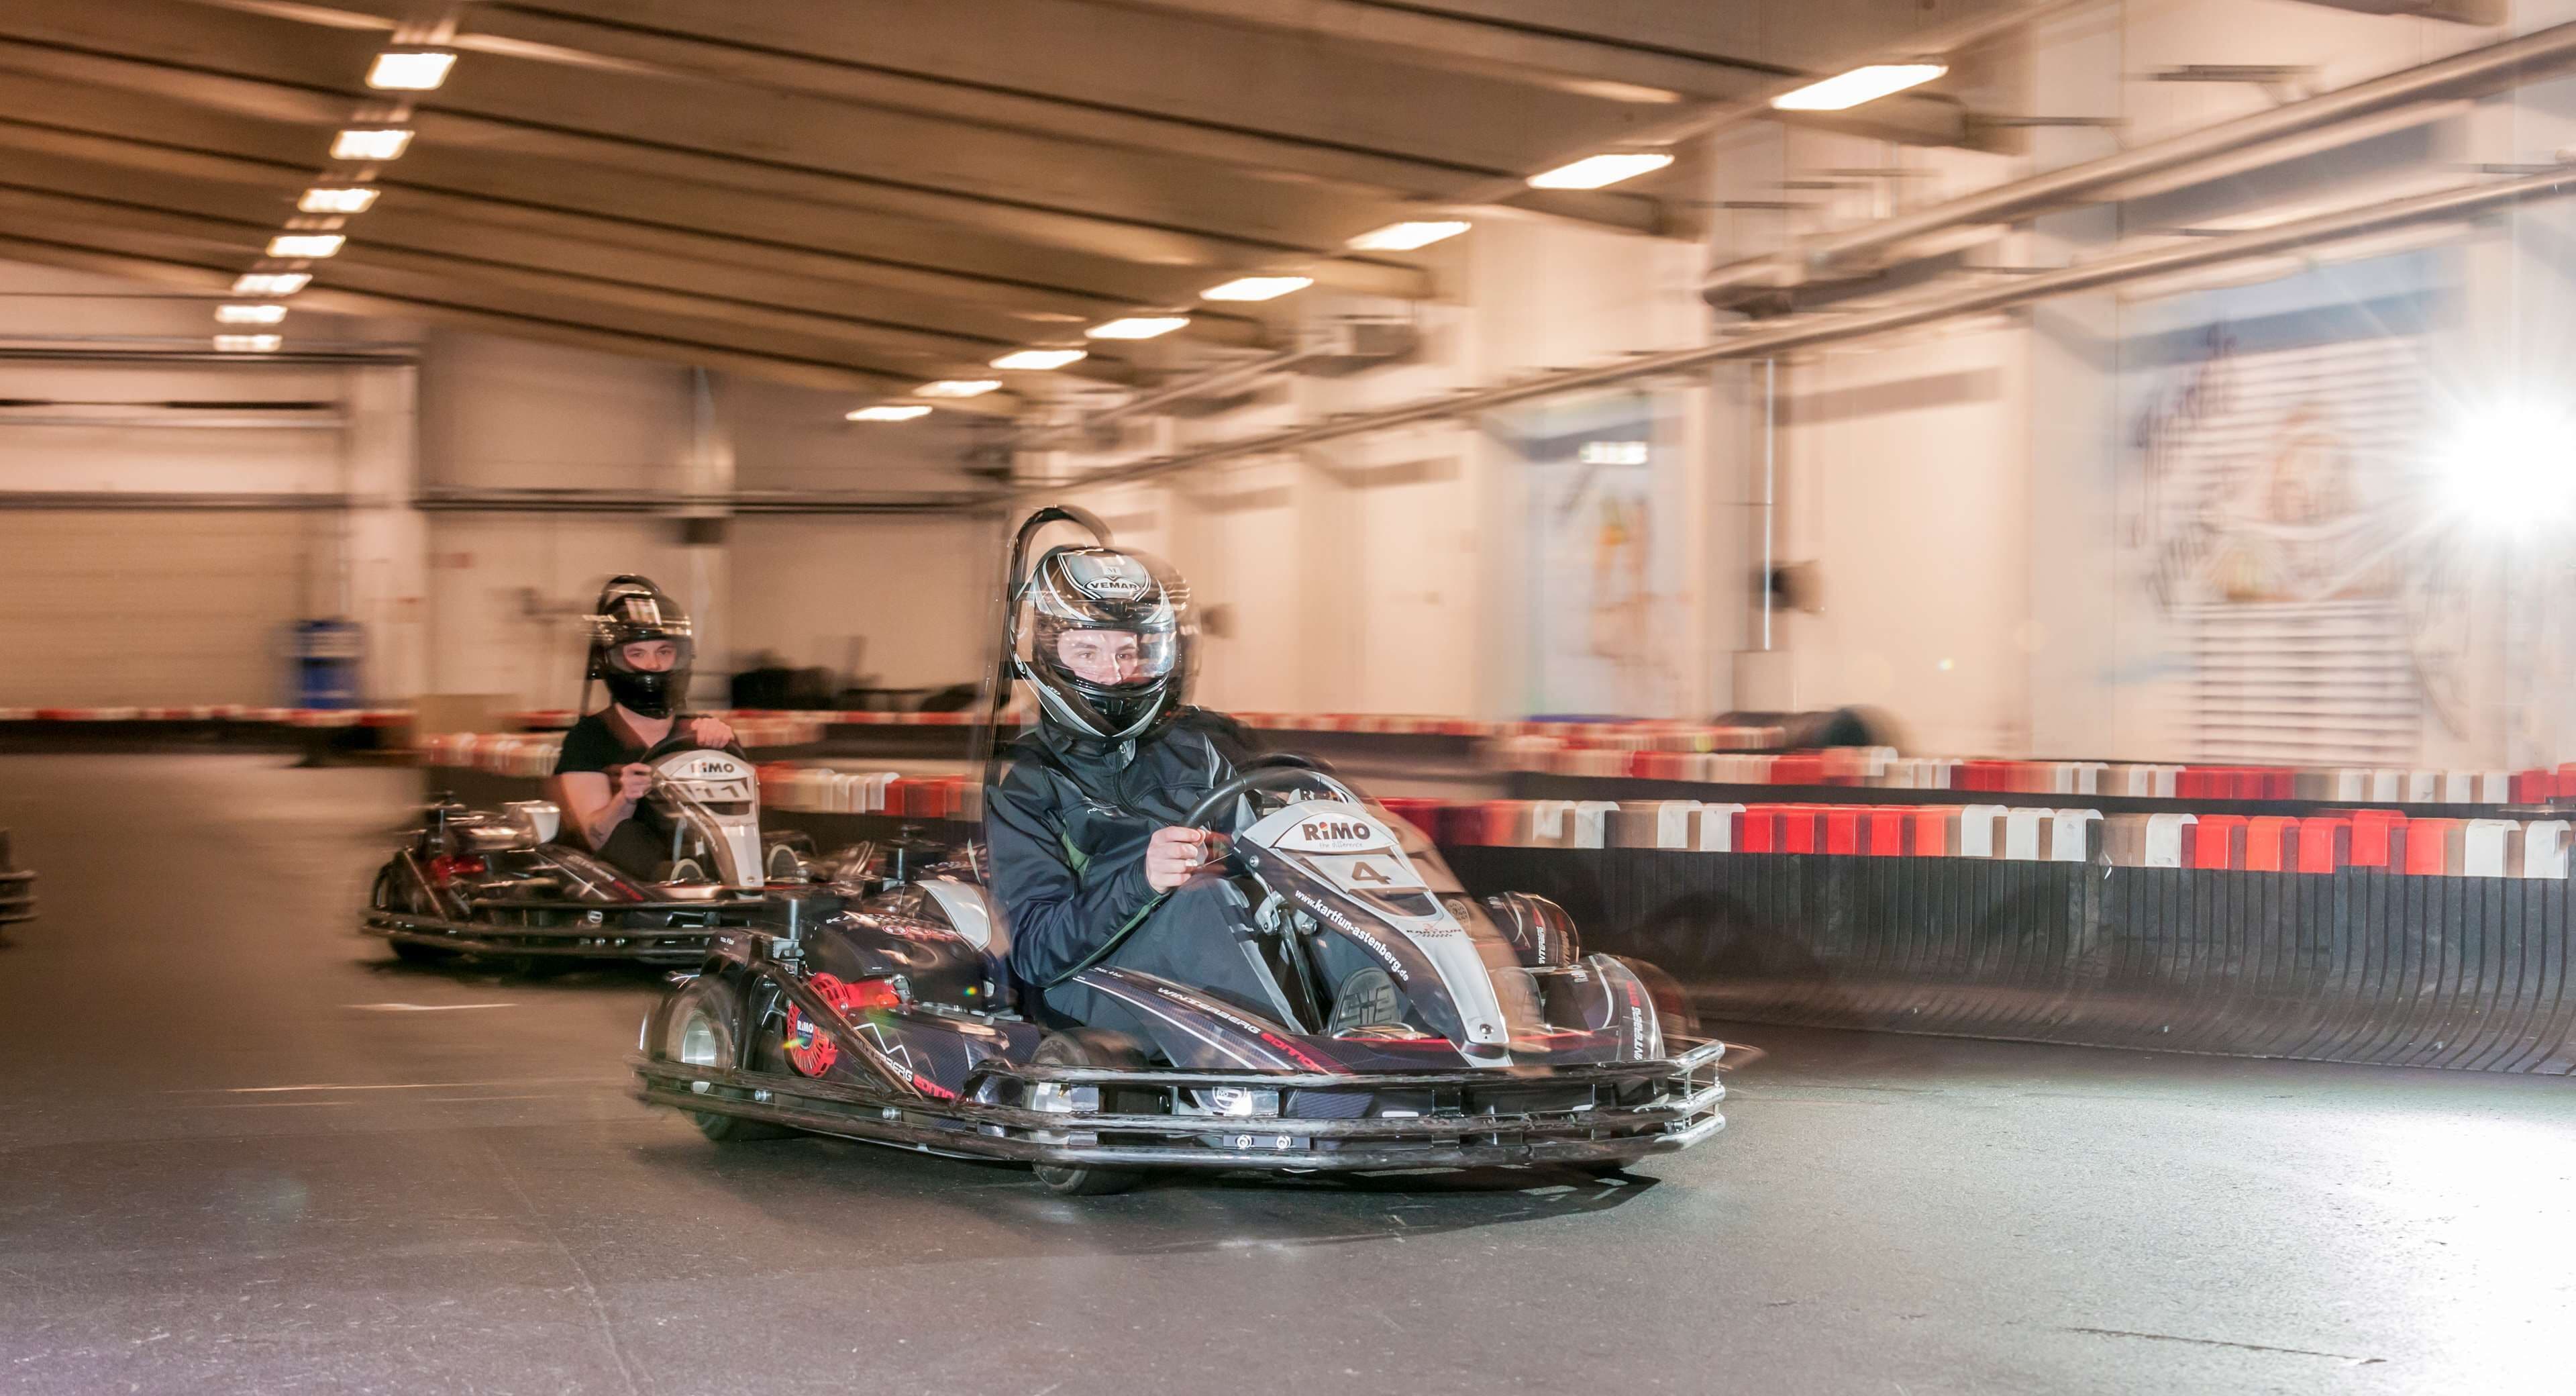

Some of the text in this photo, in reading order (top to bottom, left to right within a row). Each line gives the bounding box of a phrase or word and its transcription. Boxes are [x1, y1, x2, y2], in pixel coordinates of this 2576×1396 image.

[1090, 582, 1138, 590] VEMAR
[1351, 862, 1392, 885] 4
[1294, 890, 1409, 981] www.kartfun-astenberg.de
